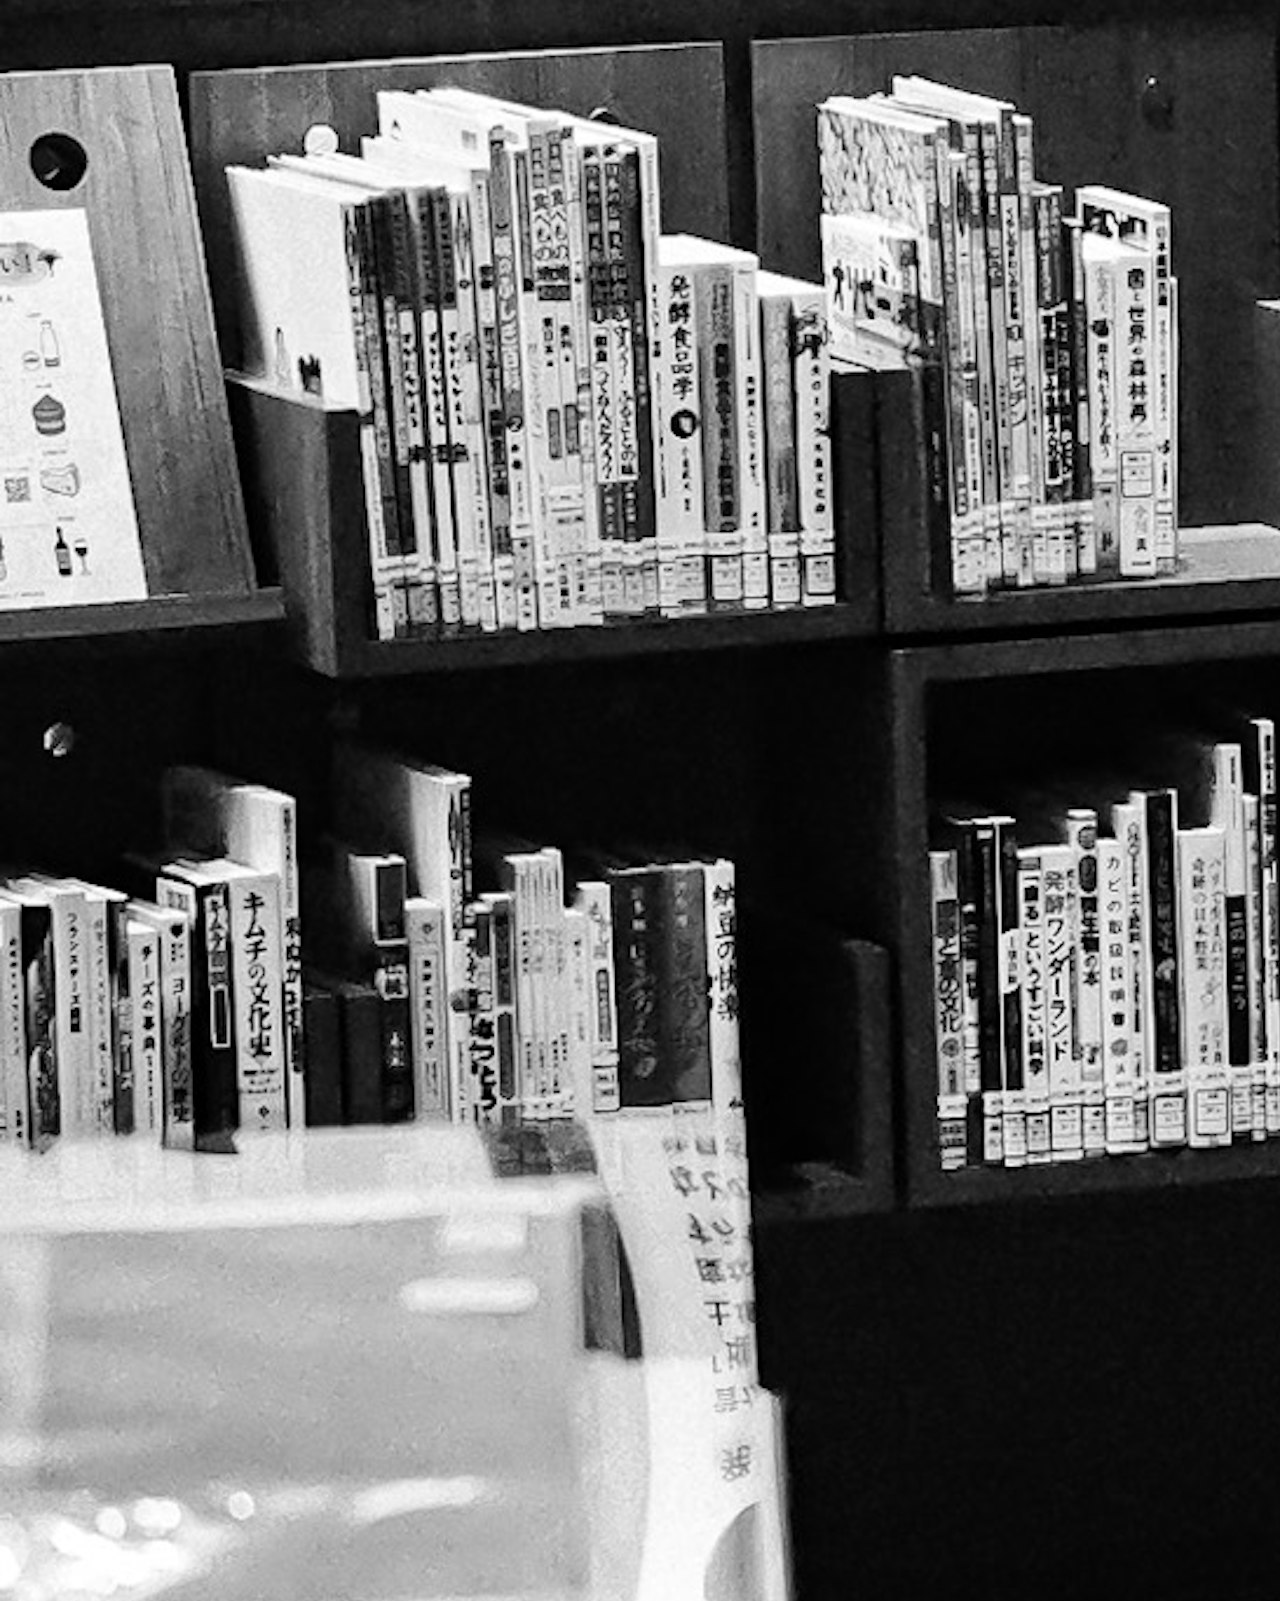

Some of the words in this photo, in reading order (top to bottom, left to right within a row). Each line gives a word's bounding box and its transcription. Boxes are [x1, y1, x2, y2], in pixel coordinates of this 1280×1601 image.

[668, 274, 694, 401] 発酵食品学
[242, 892, 273, 1058] キムチの文化史
